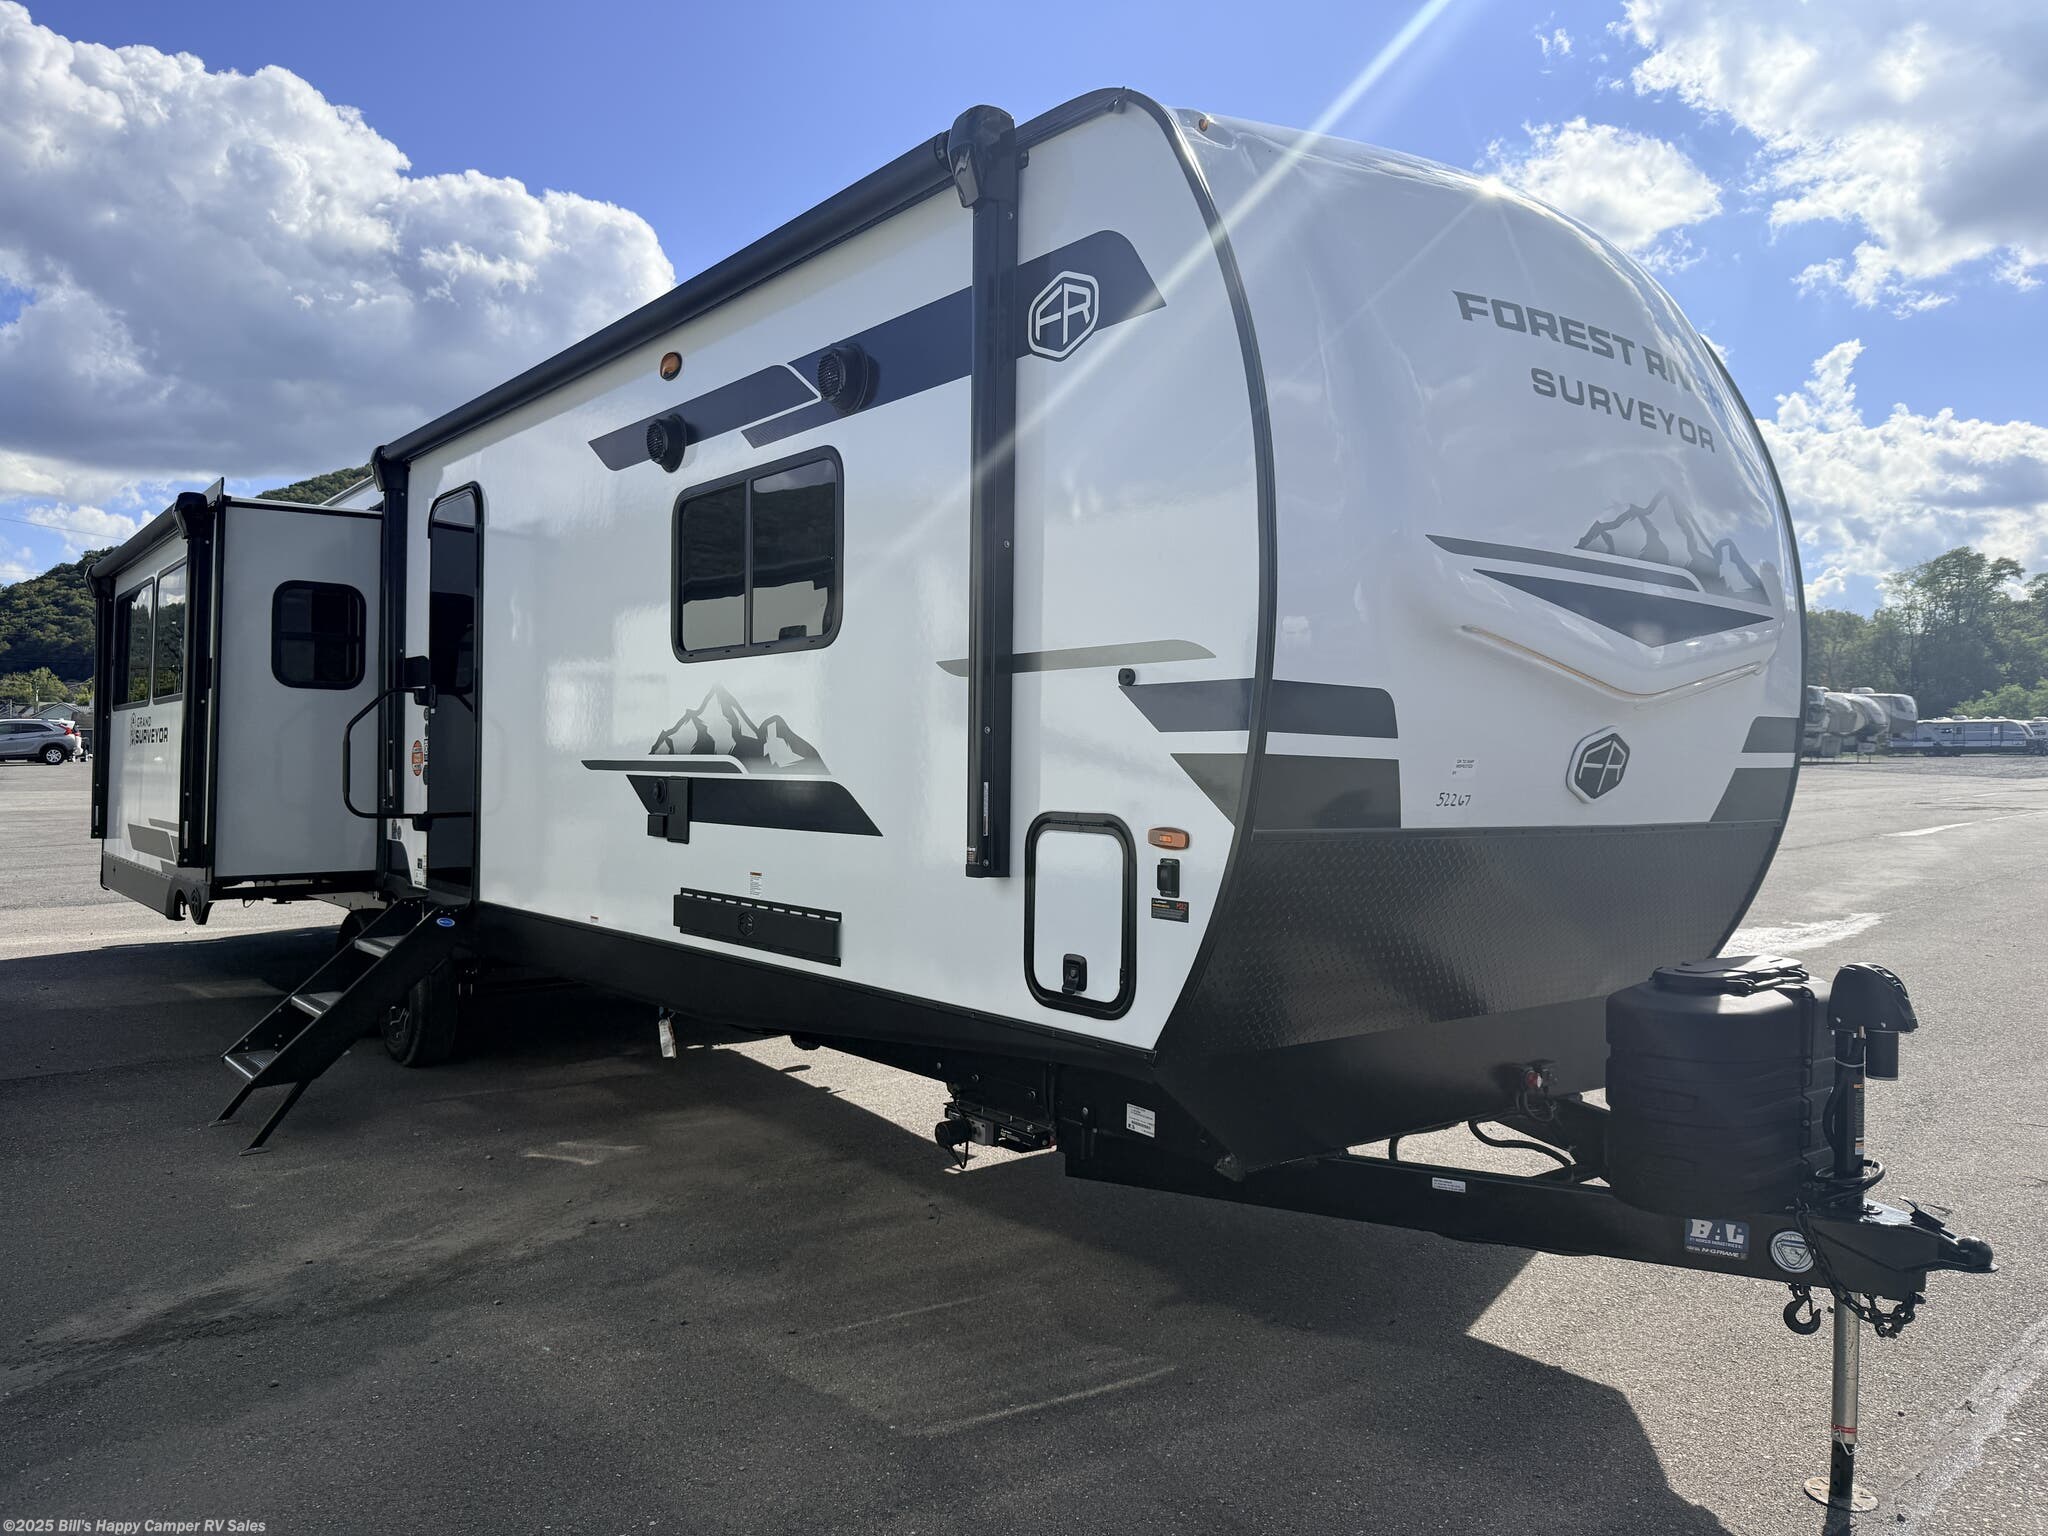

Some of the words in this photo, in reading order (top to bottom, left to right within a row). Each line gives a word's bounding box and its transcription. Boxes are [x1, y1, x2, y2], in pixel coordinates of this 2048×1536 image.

[1452, 290, 1635, 367] FOREST
[1530, 367, 1716, 453] SURVEYOR
[135, 727, 168, 744] SURVEYOR
[1435, 792, 1471, 807] 52267
